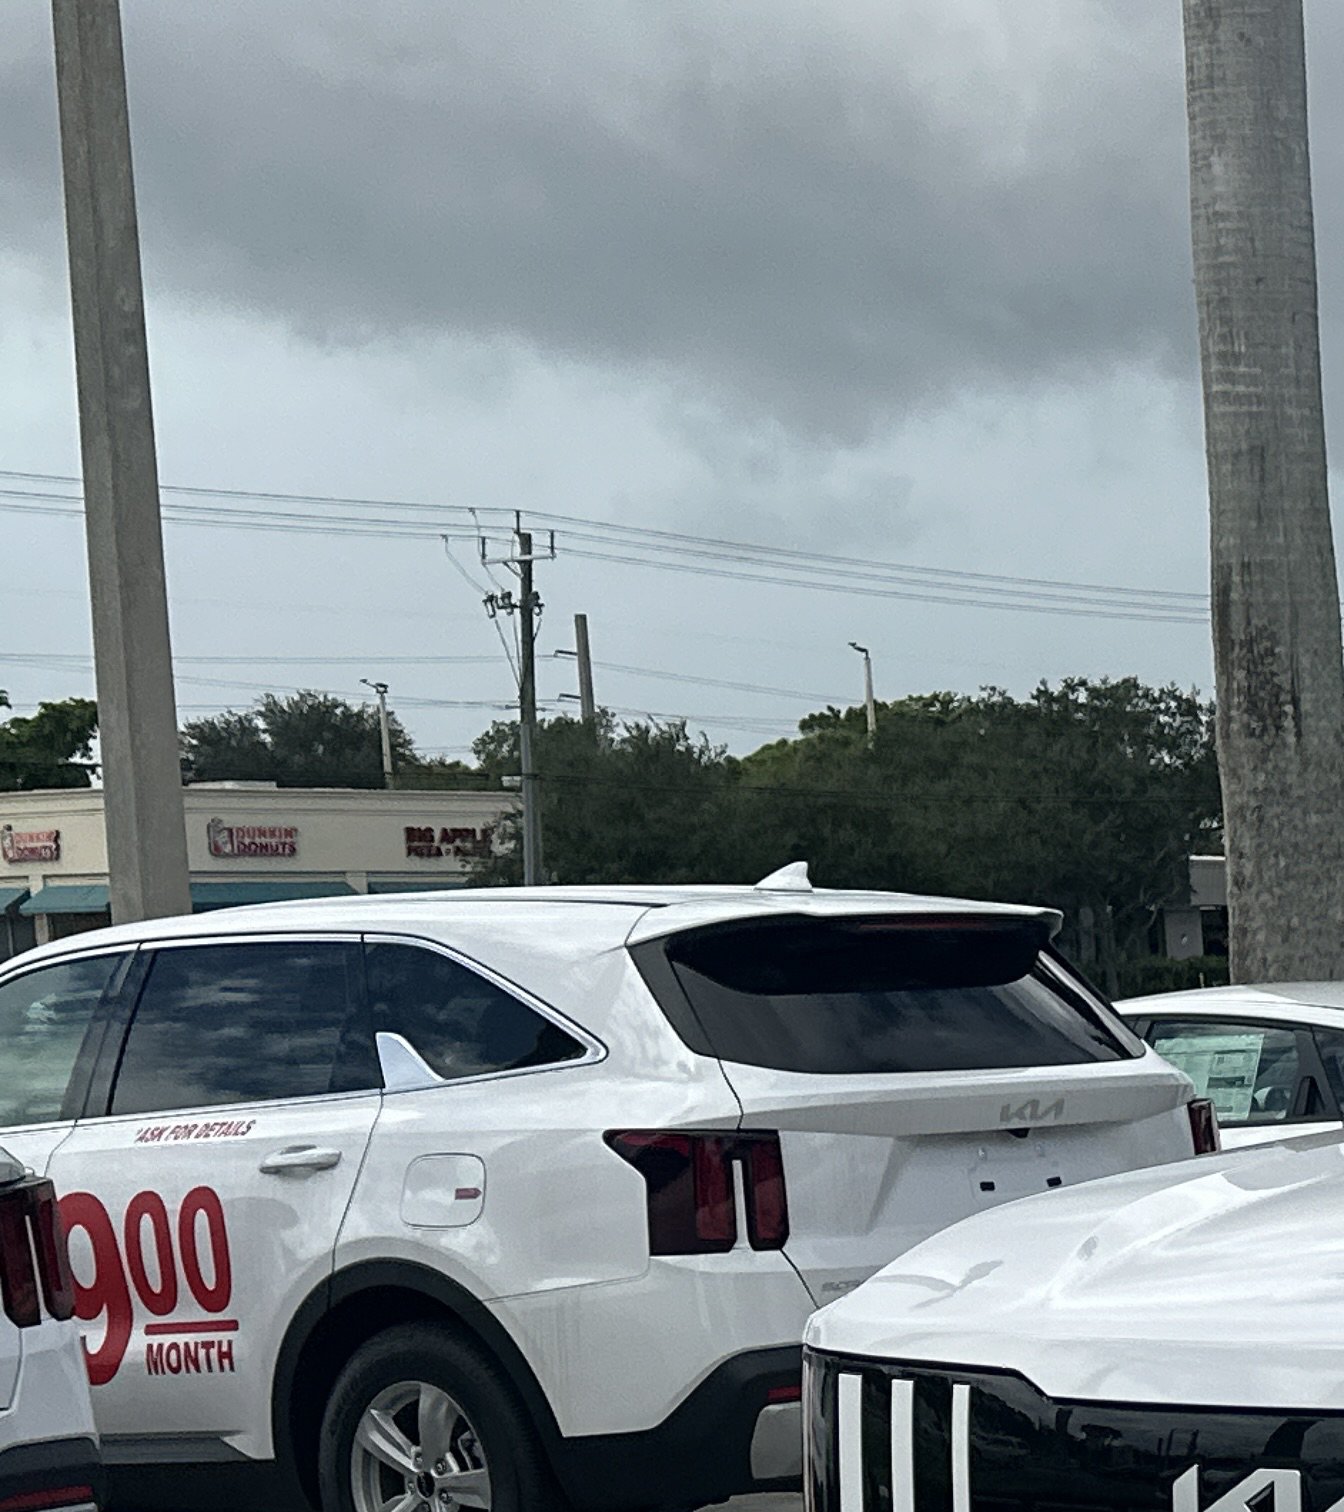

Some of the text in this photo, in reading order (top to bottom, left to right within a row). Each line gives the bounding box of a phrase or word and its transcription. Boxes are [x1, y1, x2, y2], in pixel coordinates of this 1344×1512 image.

[404, 827, 436, 844] BIG
[237, 841, 298, 857] DONUTS
[999, 1097, 1065, 1122] KIA
[164, 1122, 199, 1141] FOR
[193, 1118, 257, 1139] DETAILS
[145, 1338, 235, 1376] MONTH
